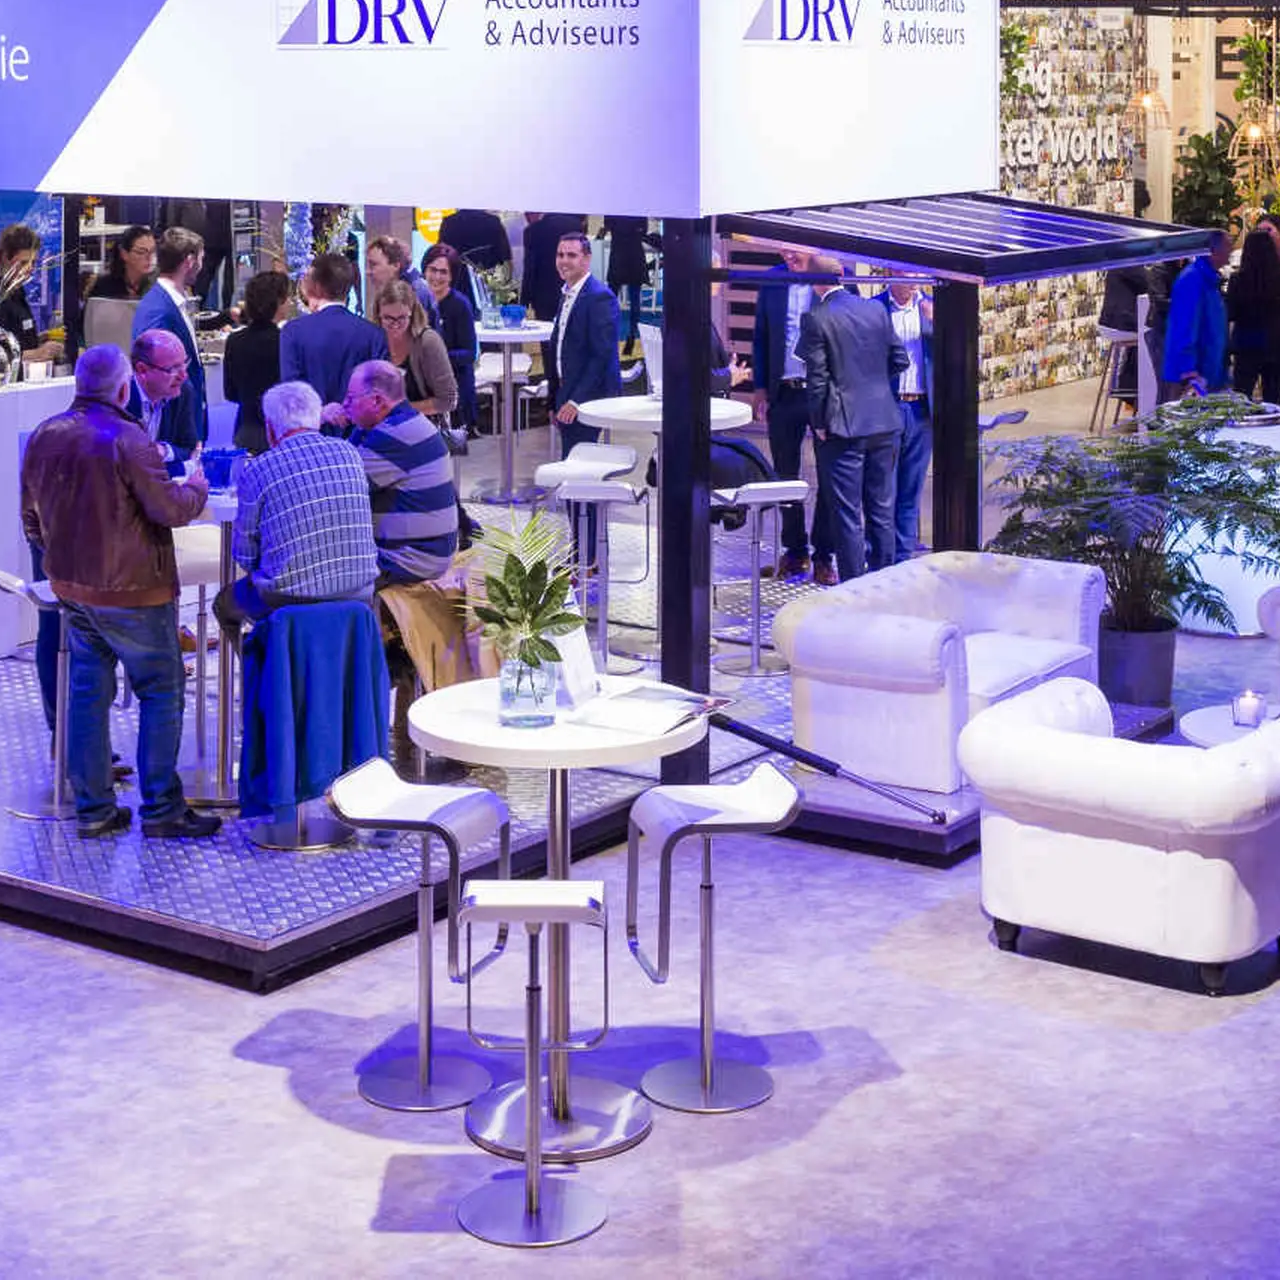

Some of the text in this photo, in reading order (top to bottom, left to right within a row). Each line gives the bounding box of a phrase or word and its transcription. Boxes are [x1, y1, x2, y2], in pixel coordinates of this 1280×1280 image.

[483, 19, 640, 46] & Adviseurs
[882, 20, 966, 45] & Adviseurs
